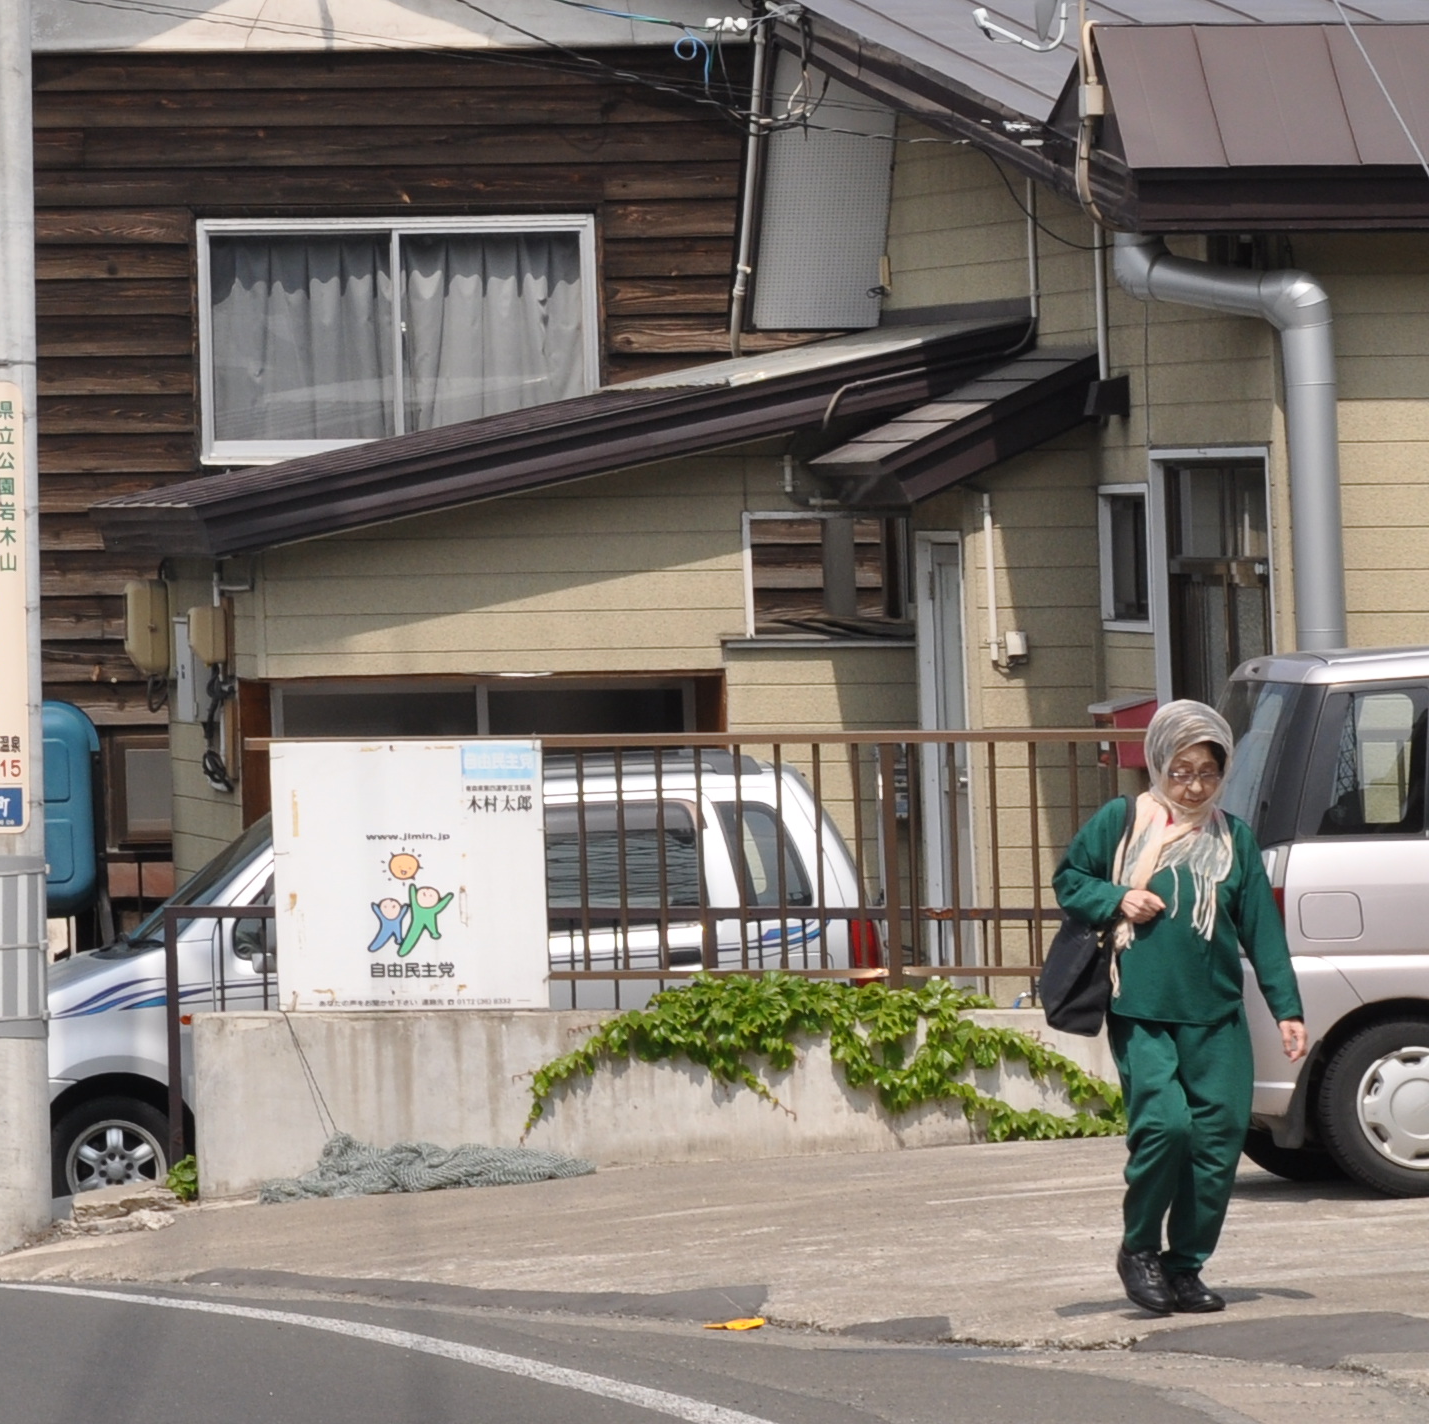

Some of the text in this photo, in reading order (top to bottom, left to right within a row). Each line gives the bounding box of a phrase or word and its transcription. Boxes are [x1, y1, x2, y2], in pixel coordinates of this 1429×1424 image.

[467, 794, 533, 814] 木村太郎
[365, 833, 451, 842] www.jimin.jp
[370, 962, 455, 978] 自由民主党
